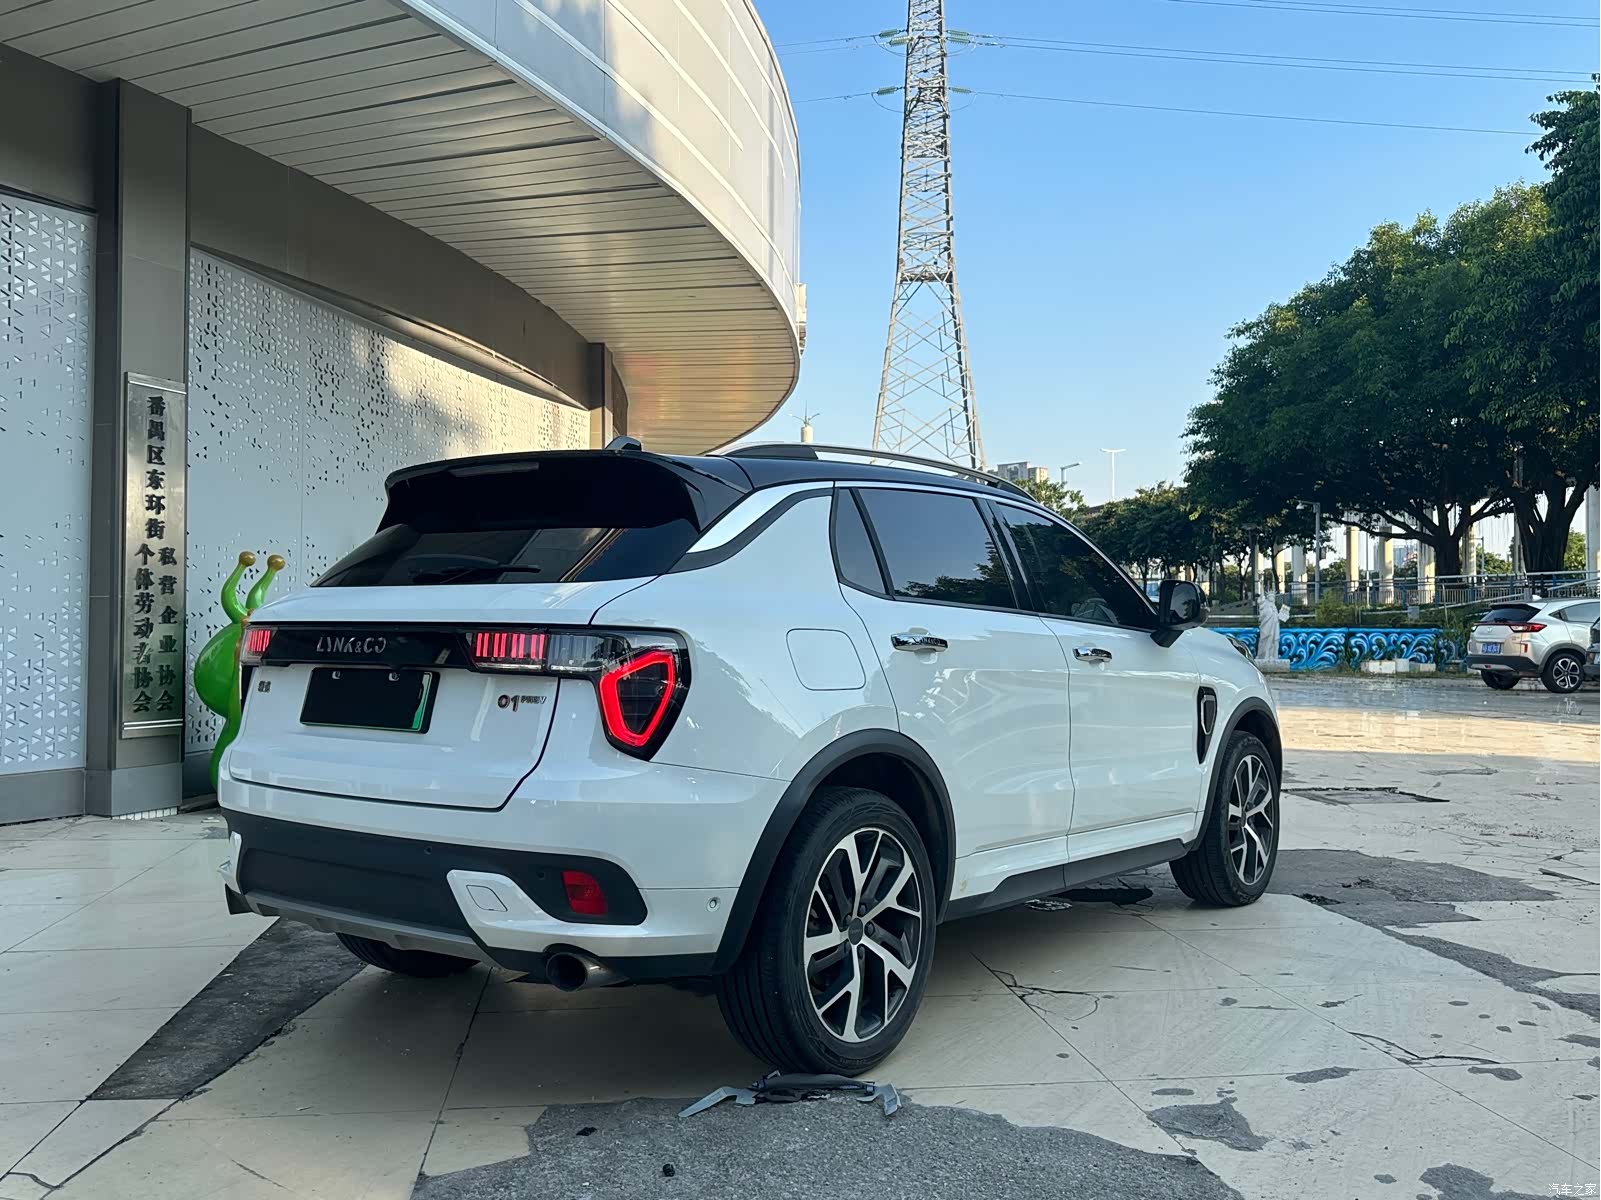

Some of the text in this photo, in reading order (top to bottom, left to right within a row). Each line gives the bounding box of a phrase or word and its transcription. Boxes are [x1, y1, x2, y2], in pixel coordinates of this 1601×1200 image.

[145, 395, 166, 540] 番禺区东环街
[156, 546, 178, 712] 私营企业协会
